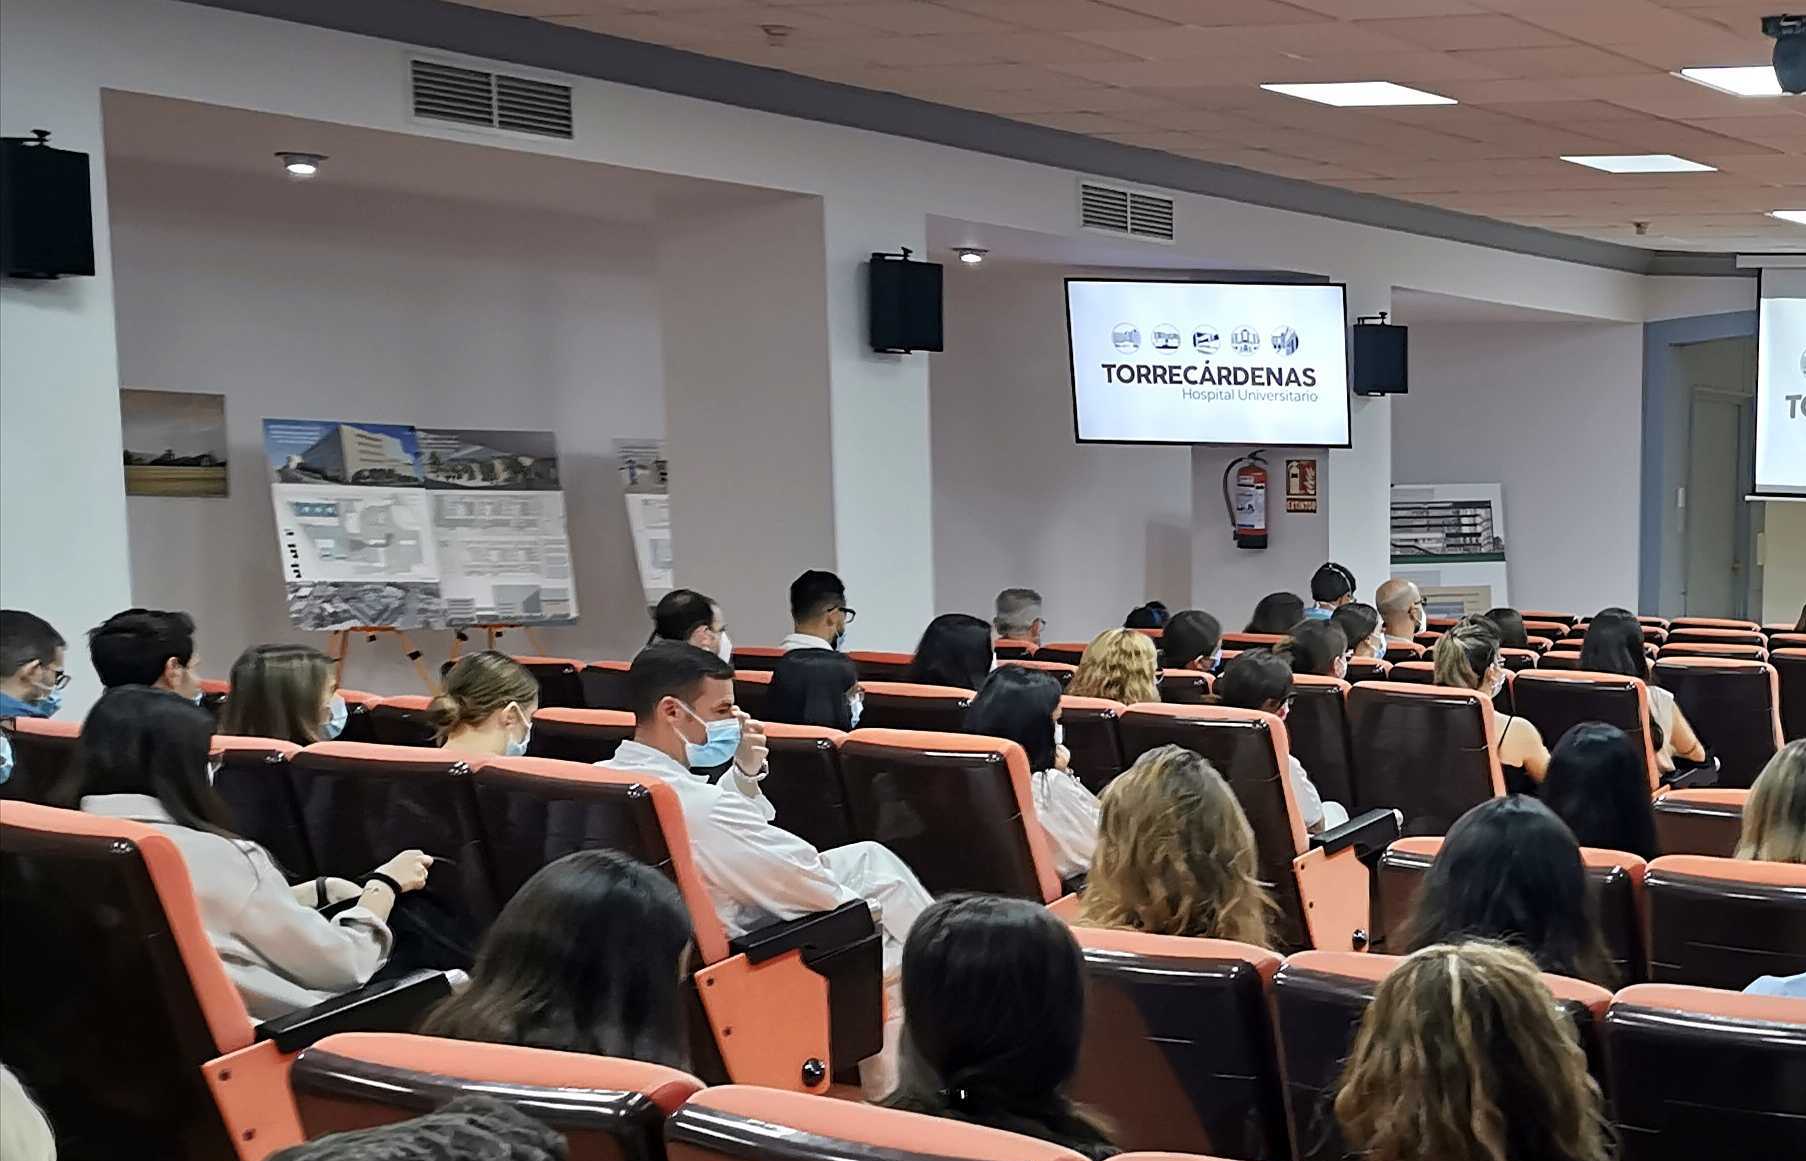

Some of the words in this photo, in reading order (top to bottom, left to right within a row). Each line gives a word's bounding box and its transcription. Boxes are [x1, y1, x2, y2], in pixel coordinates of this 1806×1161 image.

[1101, 360, 1317, 387] TORRECÁRDENAS
[1181, 388, 1235, 403] Hospital
[1237, 389, 1319, 403] Universitario
